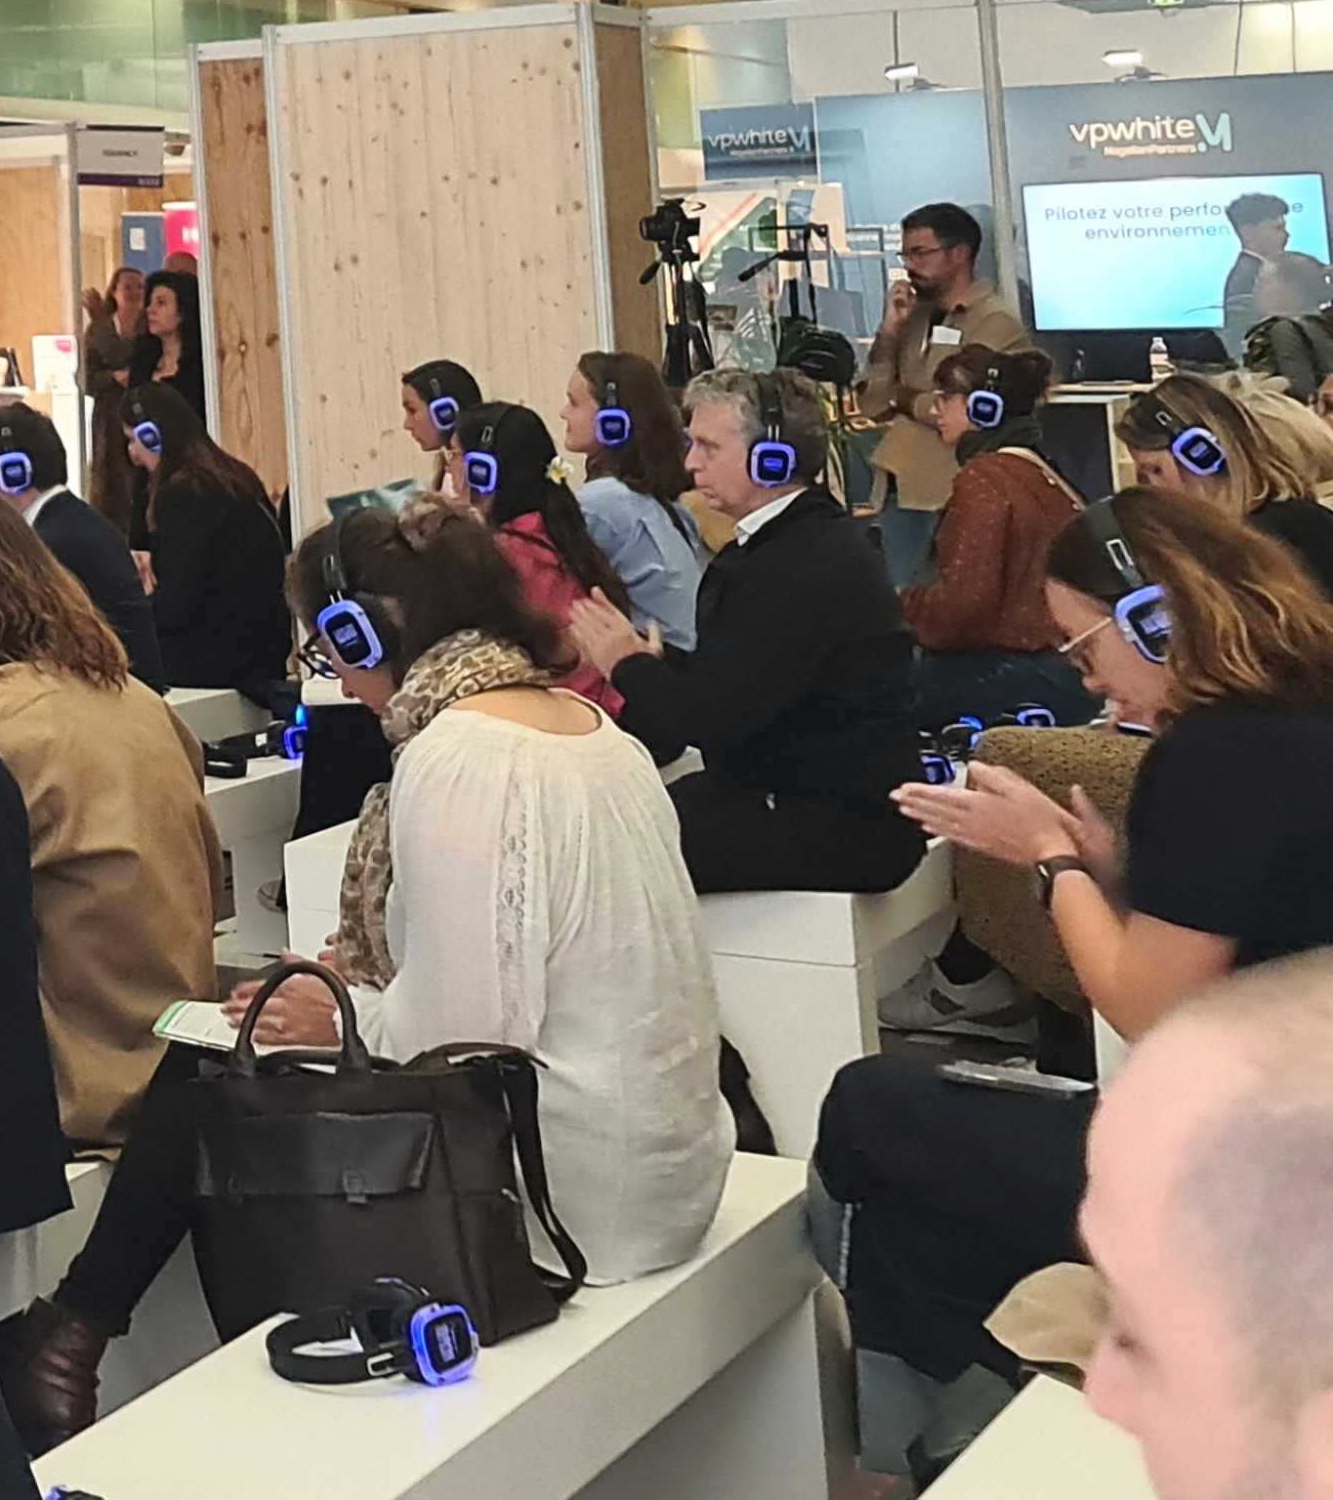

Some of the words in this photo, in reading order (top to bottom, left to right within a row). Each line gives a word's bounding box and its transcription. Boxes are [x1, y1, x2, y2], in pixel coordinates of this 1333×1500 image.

[707, 128, 789, 152] vpwhite
[1068, 115, 1196, 150] vpwhite
[1044, 207, 1107, 221] Pilotez
[1112, 206, 1164, 220] votre
[1169, 201, 1304, 221] perfoe
[1084, 223, 1232, 240] environnemen
